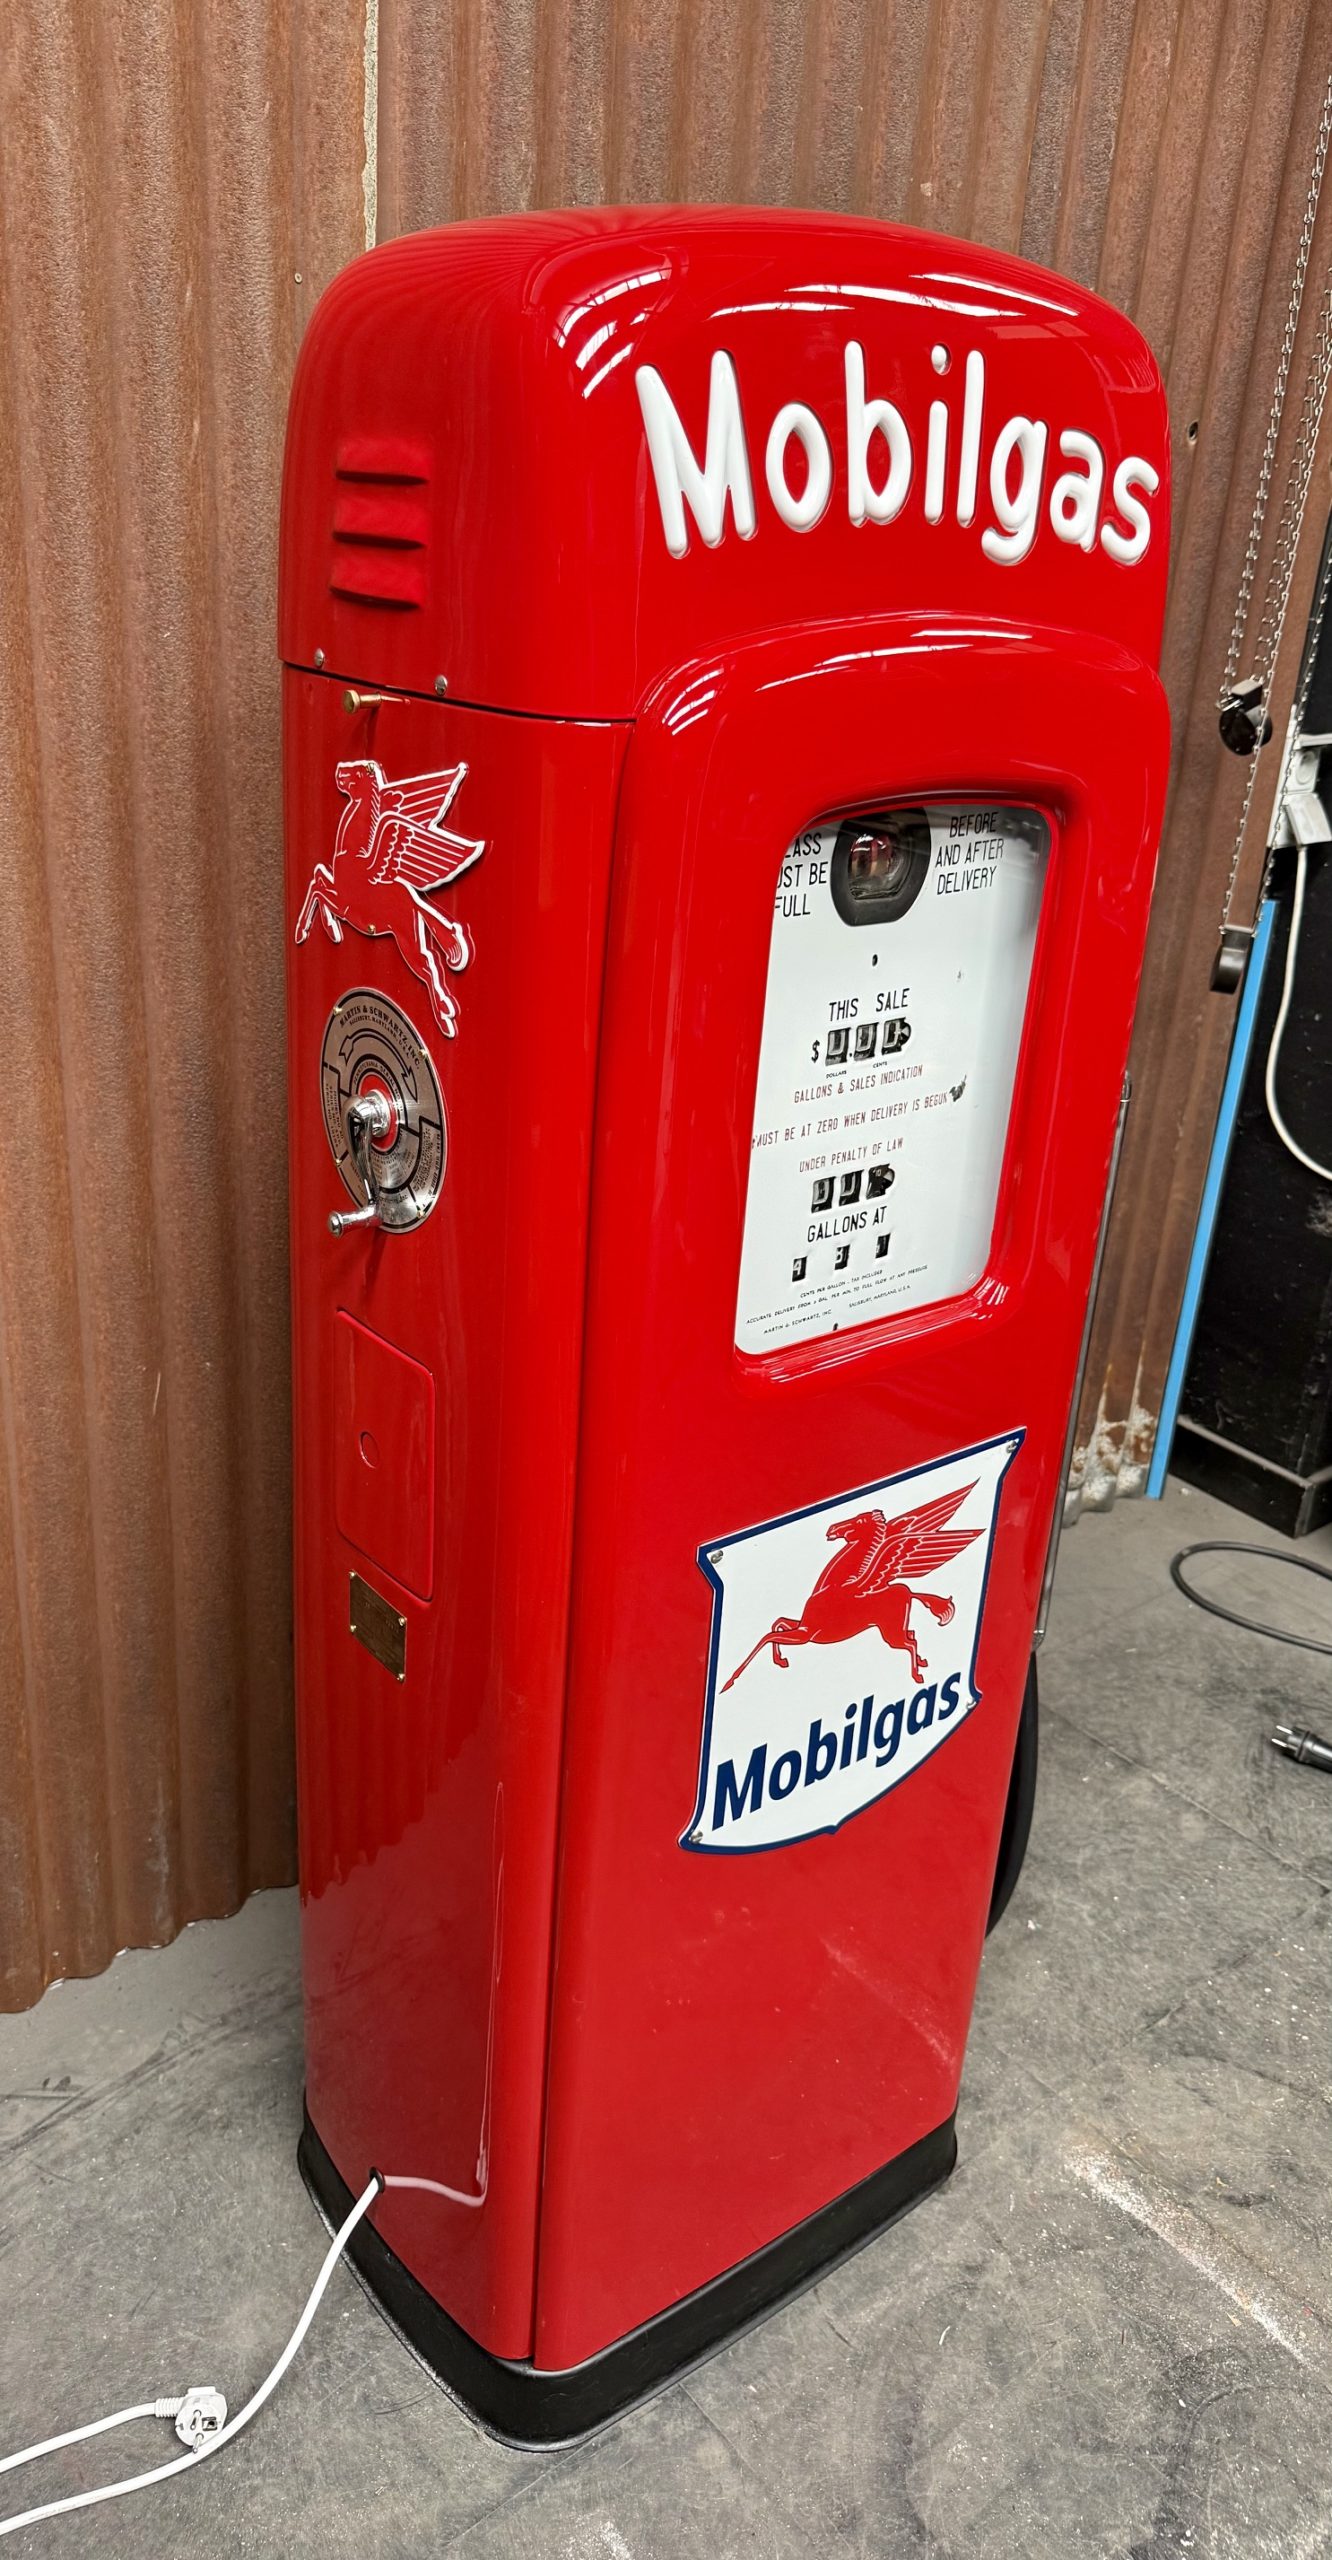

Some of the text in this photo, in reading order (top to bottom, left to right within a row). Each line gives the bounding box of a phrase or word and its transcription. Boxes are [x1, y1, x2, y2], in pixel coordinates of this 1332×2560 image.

[635, 340, 1159, 567] Mobilgas
[949, 811, 999, 838] BEFORE
[785, 832, 822, 858] ASS
[935, 838, 1004, 868] AND AFTER
[809, 861, 828, 885] BE
[937, 865, 997, 895] DELIVERY
[363, 1005, 368, 1013] &
[829, 988, 910, 1021] THIS SALE
[811, 1039, 820, 1063] $
[794, 1064, 923, 1103] GALLONS & SALES INDICATION
[826, 1070, 847, 1079] DOLLARS
[784, 1127, 795, 1141] BE
[801, 1123, 811, 1138] AT
[817, 1118, 838, 1134] ZERO
[844, 1111, 866, 1128] WHEN
[871, 1101, 908, 1121] DELIVERY
[912, 1098, 920, 1111] IS
[799, 1137, 903, 1172] UNDER PENALTY OF LAW
[807, 1205, 888, 1243] GALLONS AT
[711, 1671, 963, 1831] Mobilgas
